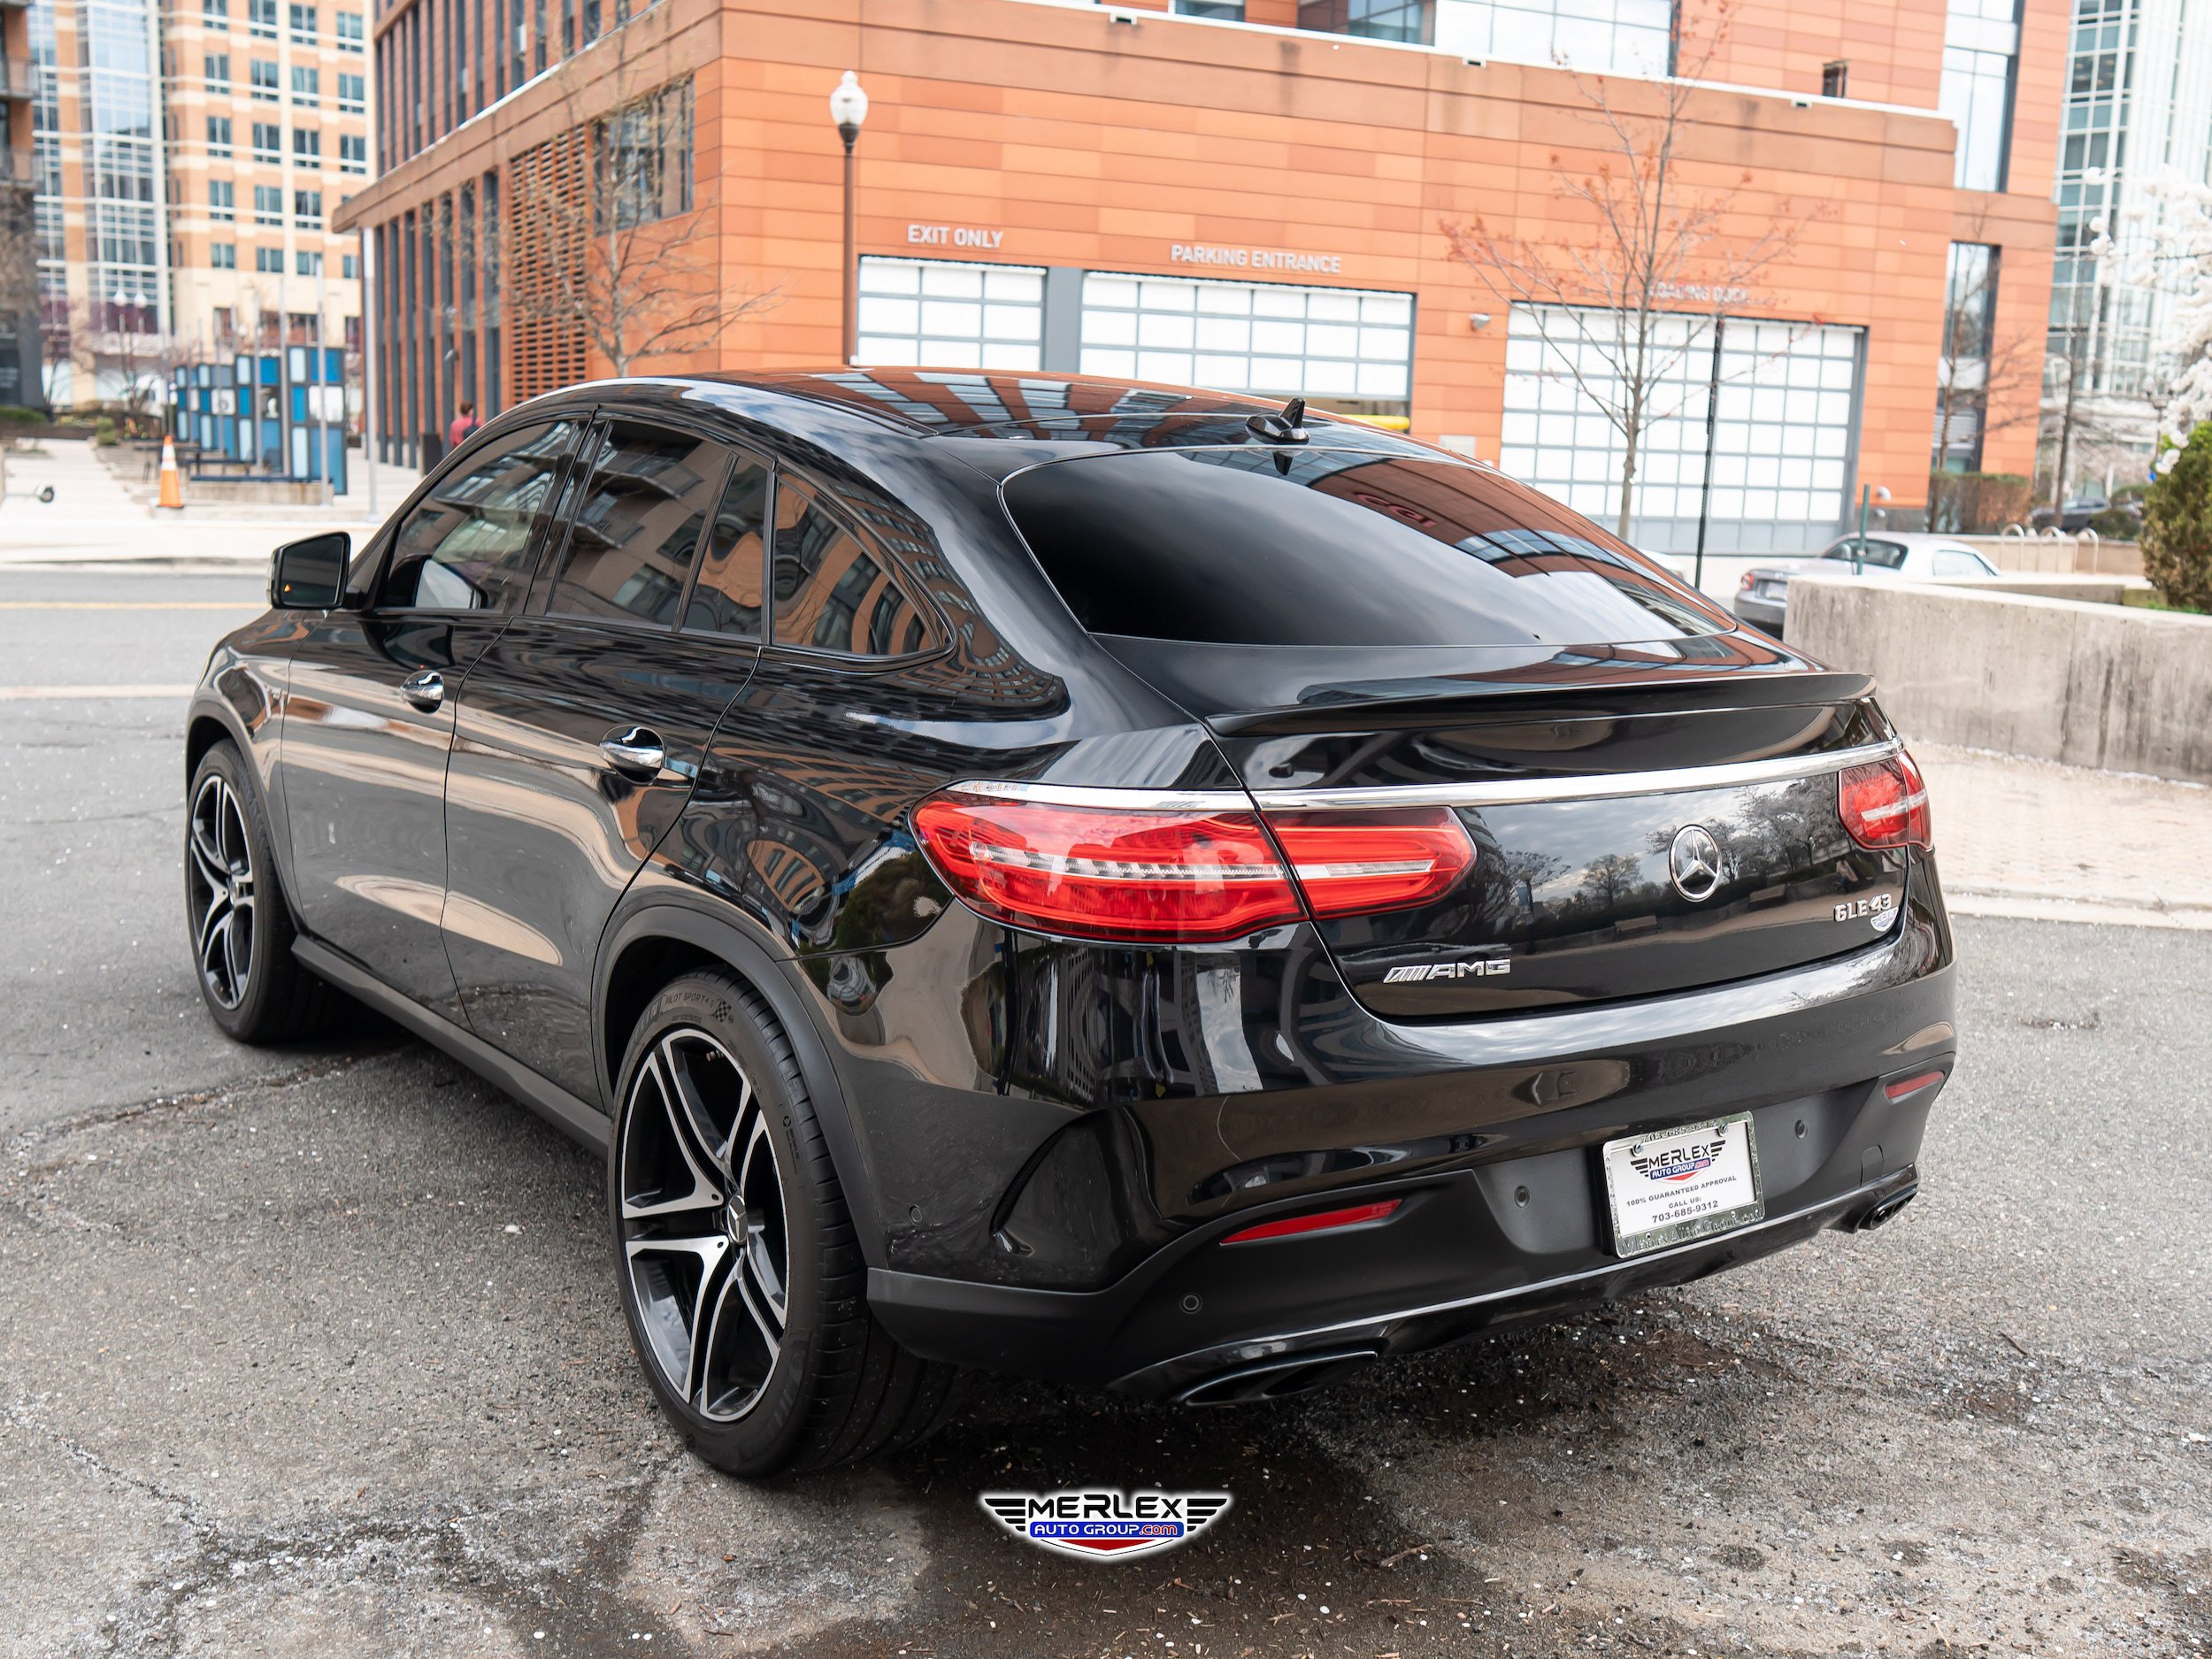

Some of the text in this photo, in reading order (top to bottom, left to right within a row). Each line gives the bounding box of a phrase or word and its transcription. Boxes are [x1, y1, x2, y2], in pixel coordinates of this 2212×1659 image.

[907, 224, 1003, 249] EXIT ONLY
[1171, 243, 1342, 273] PARKING ENTRANCE
[1834, 899, 1868, 922] GLE
[1869, 893, 1892, 912] 43
[1425, 958, 1511, 980] AMG
[664, 992, 683, 1005] PILOT
[683, 992, 706, 1004] SPORT
[1648, 1143, 1711, 1170] MERLEX
[1652, 1167, 1671, 1179] AUTO
[1626, 1175, 1737, 1207] 100% GUARANTEED APPROVAL
[1652, 1200, 1718, 1224] 703-685-9312
[1669, 1199, 1687, 1209] CALL
